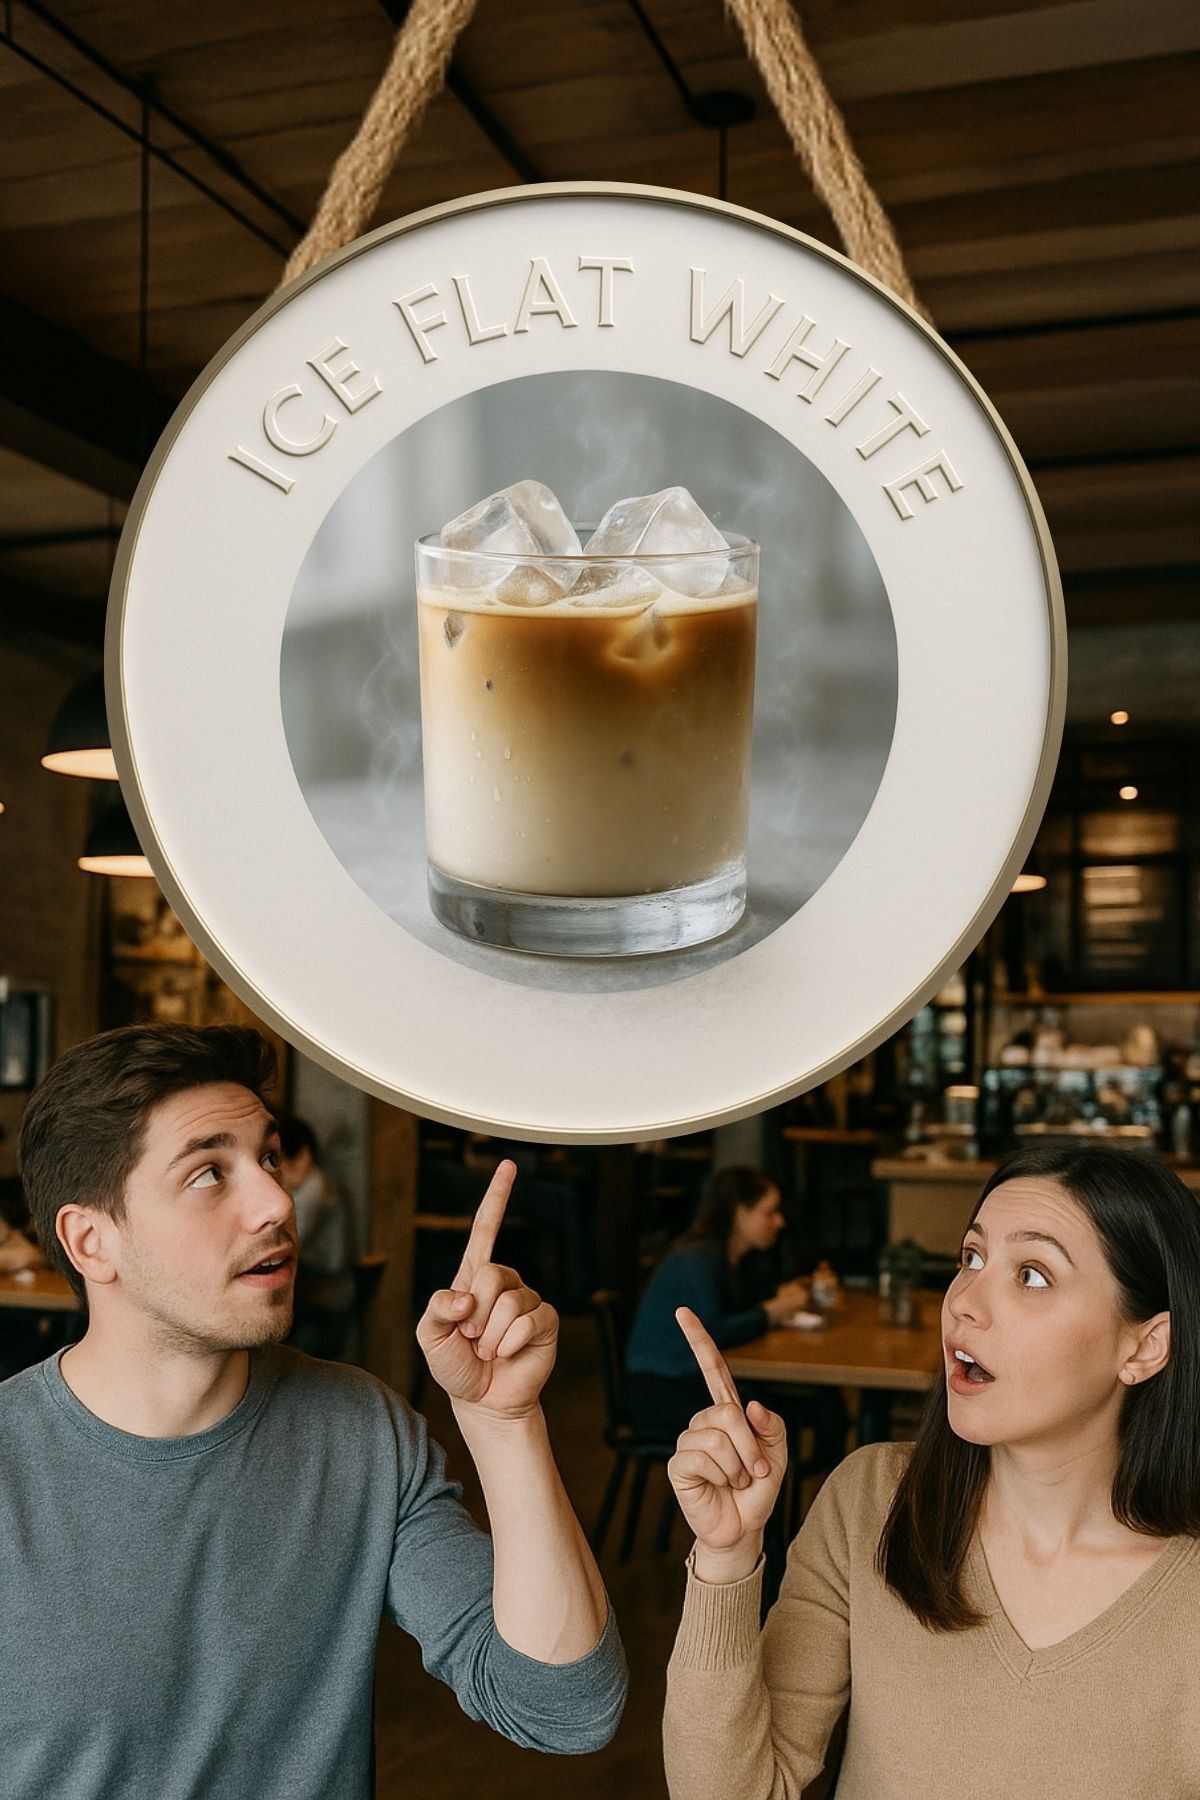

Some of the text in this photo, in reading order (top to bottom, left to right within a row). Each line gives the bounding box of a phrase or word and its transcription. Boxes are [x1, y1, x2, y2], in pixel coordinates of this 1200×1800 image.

[228, 256, 964, 520] ICE FLAT WHITE
